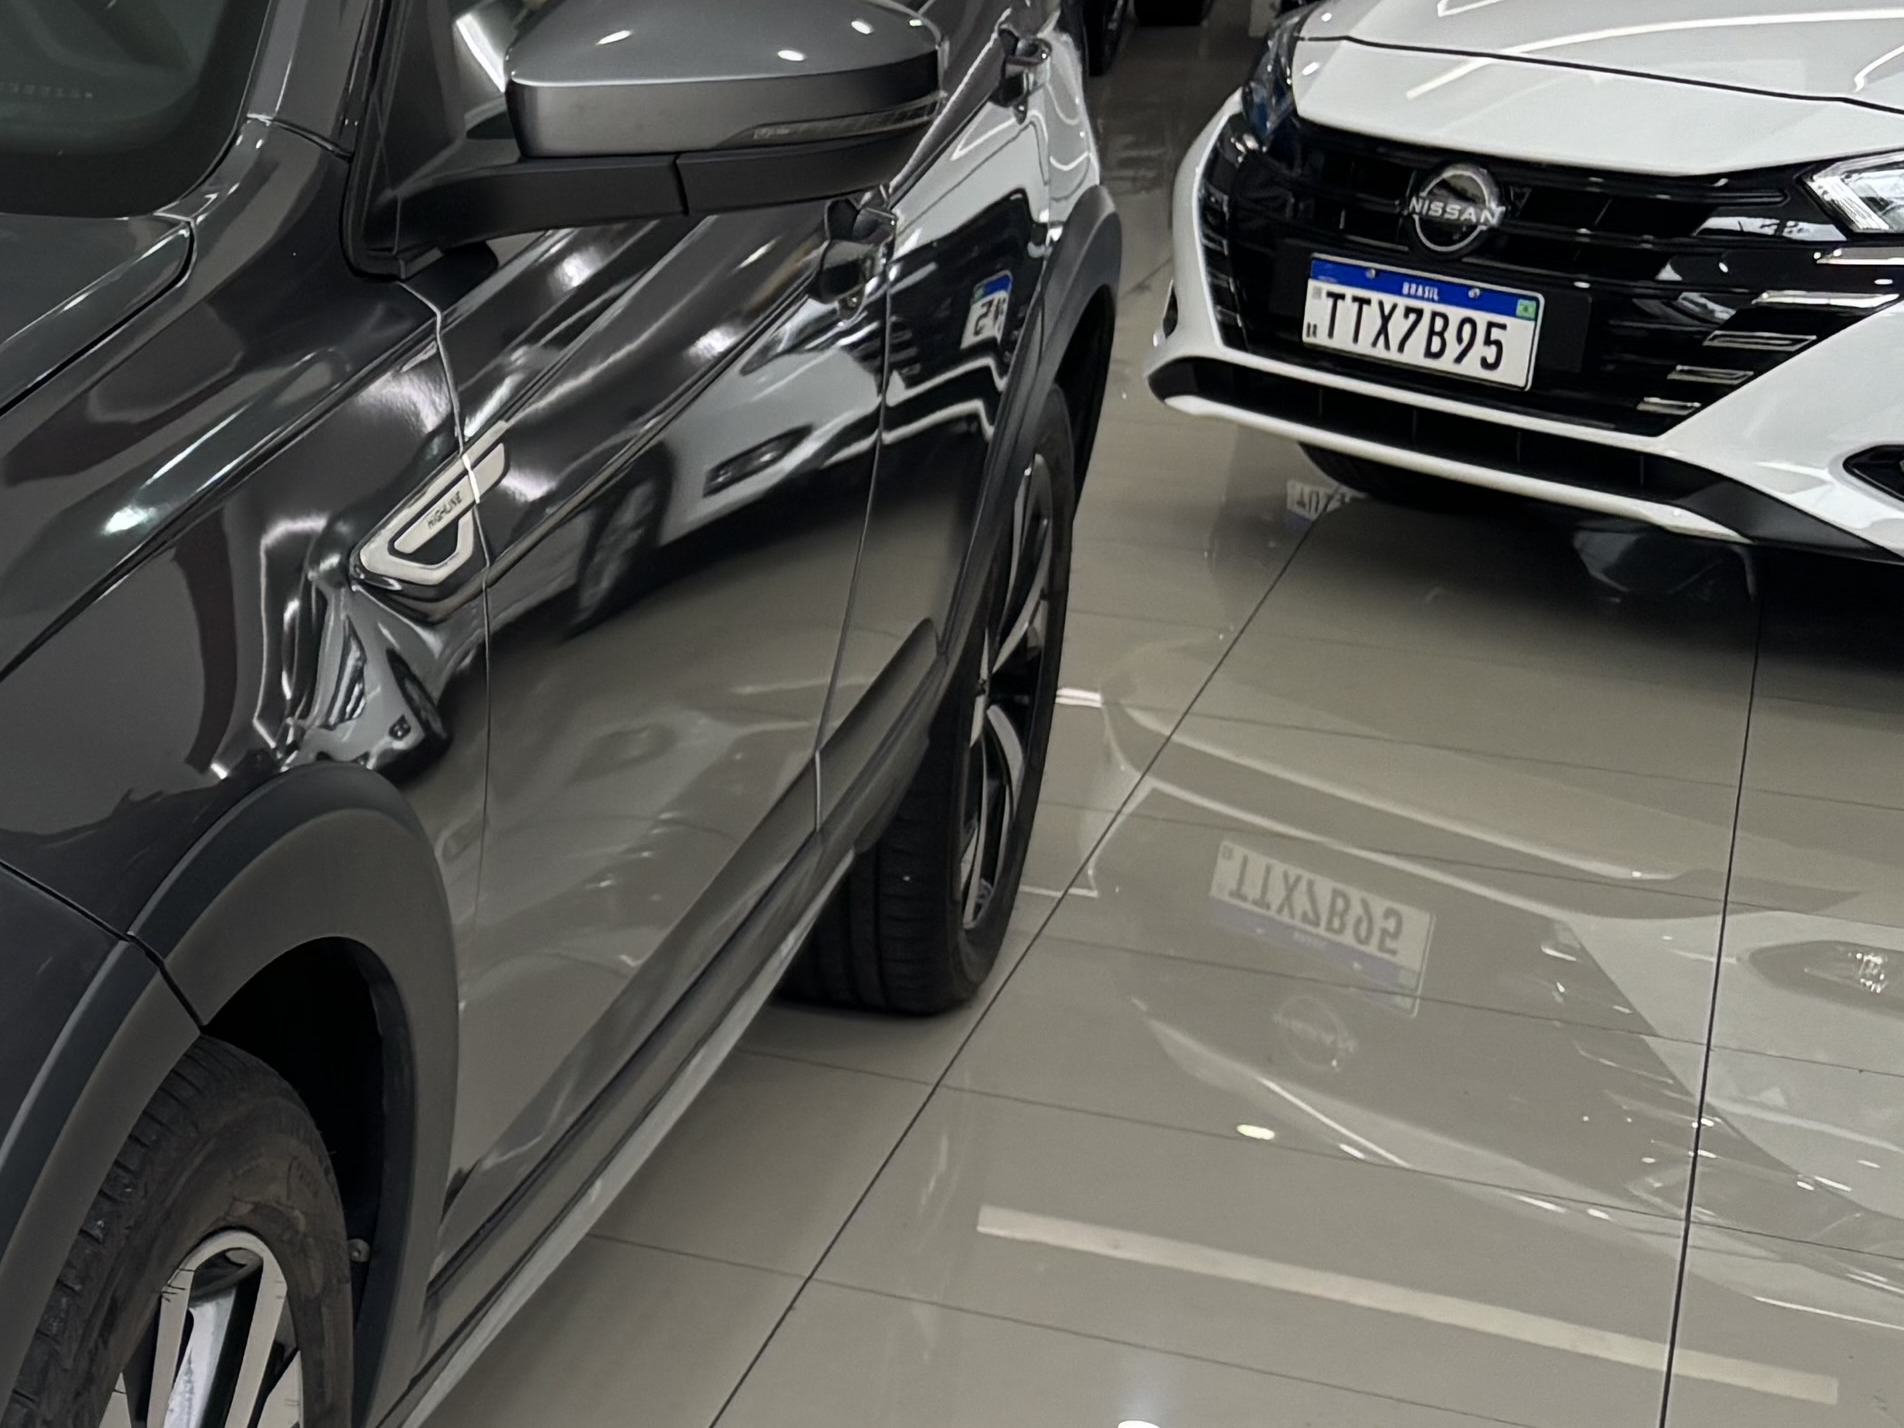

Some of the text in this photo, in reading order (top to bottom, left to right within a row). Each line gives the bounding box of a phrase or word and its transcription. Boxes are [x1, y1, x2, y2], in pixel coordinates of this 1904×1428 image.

[1409, 196, 1505, 226] NISSAN
[1402, 281, 1439, 301] BRASIL
[1326, 291, 1507, 371] TTX7B95
